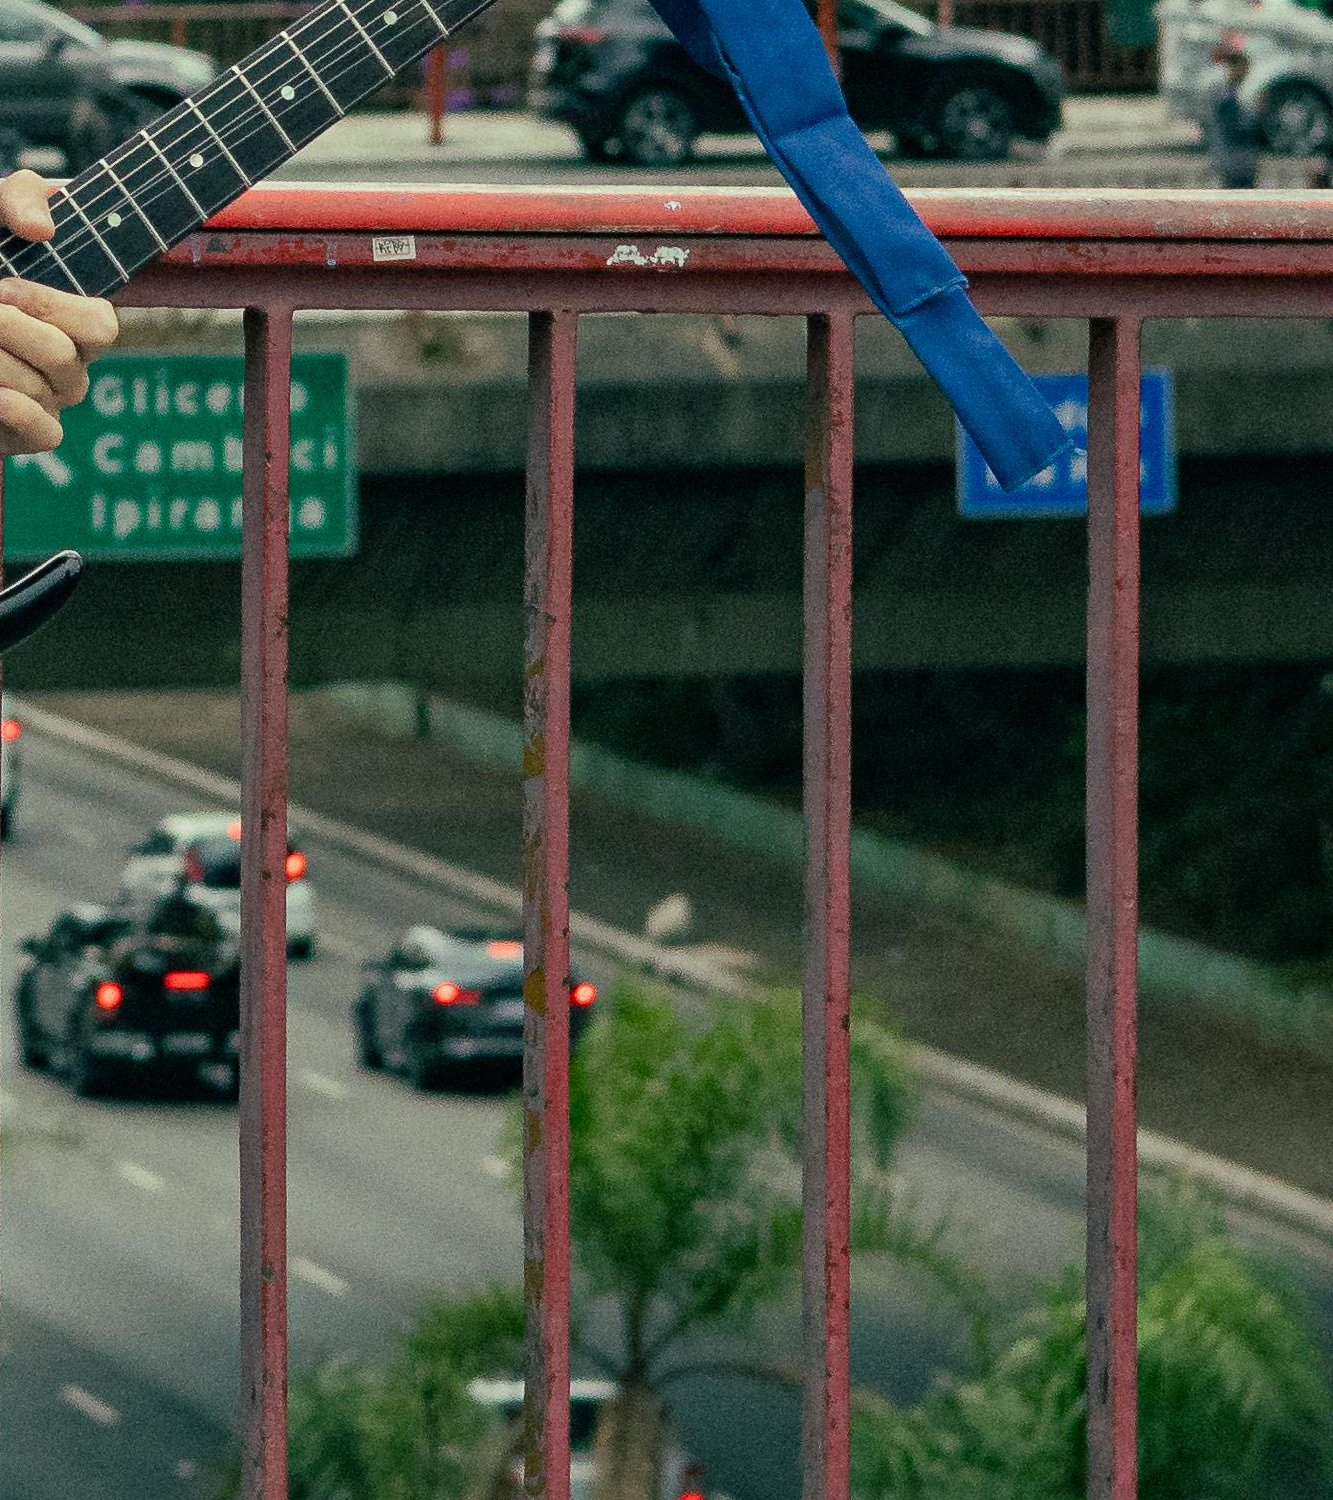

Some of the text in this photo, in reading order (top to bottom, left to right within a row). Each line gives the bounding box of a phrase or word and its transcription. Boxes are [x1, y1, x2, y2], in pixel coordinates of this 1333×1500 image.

[92, 374, 309, 416] Gliceo
[92, 431, 337, 473] Cambci
[91, 493, 326, 539] Ipiraa
